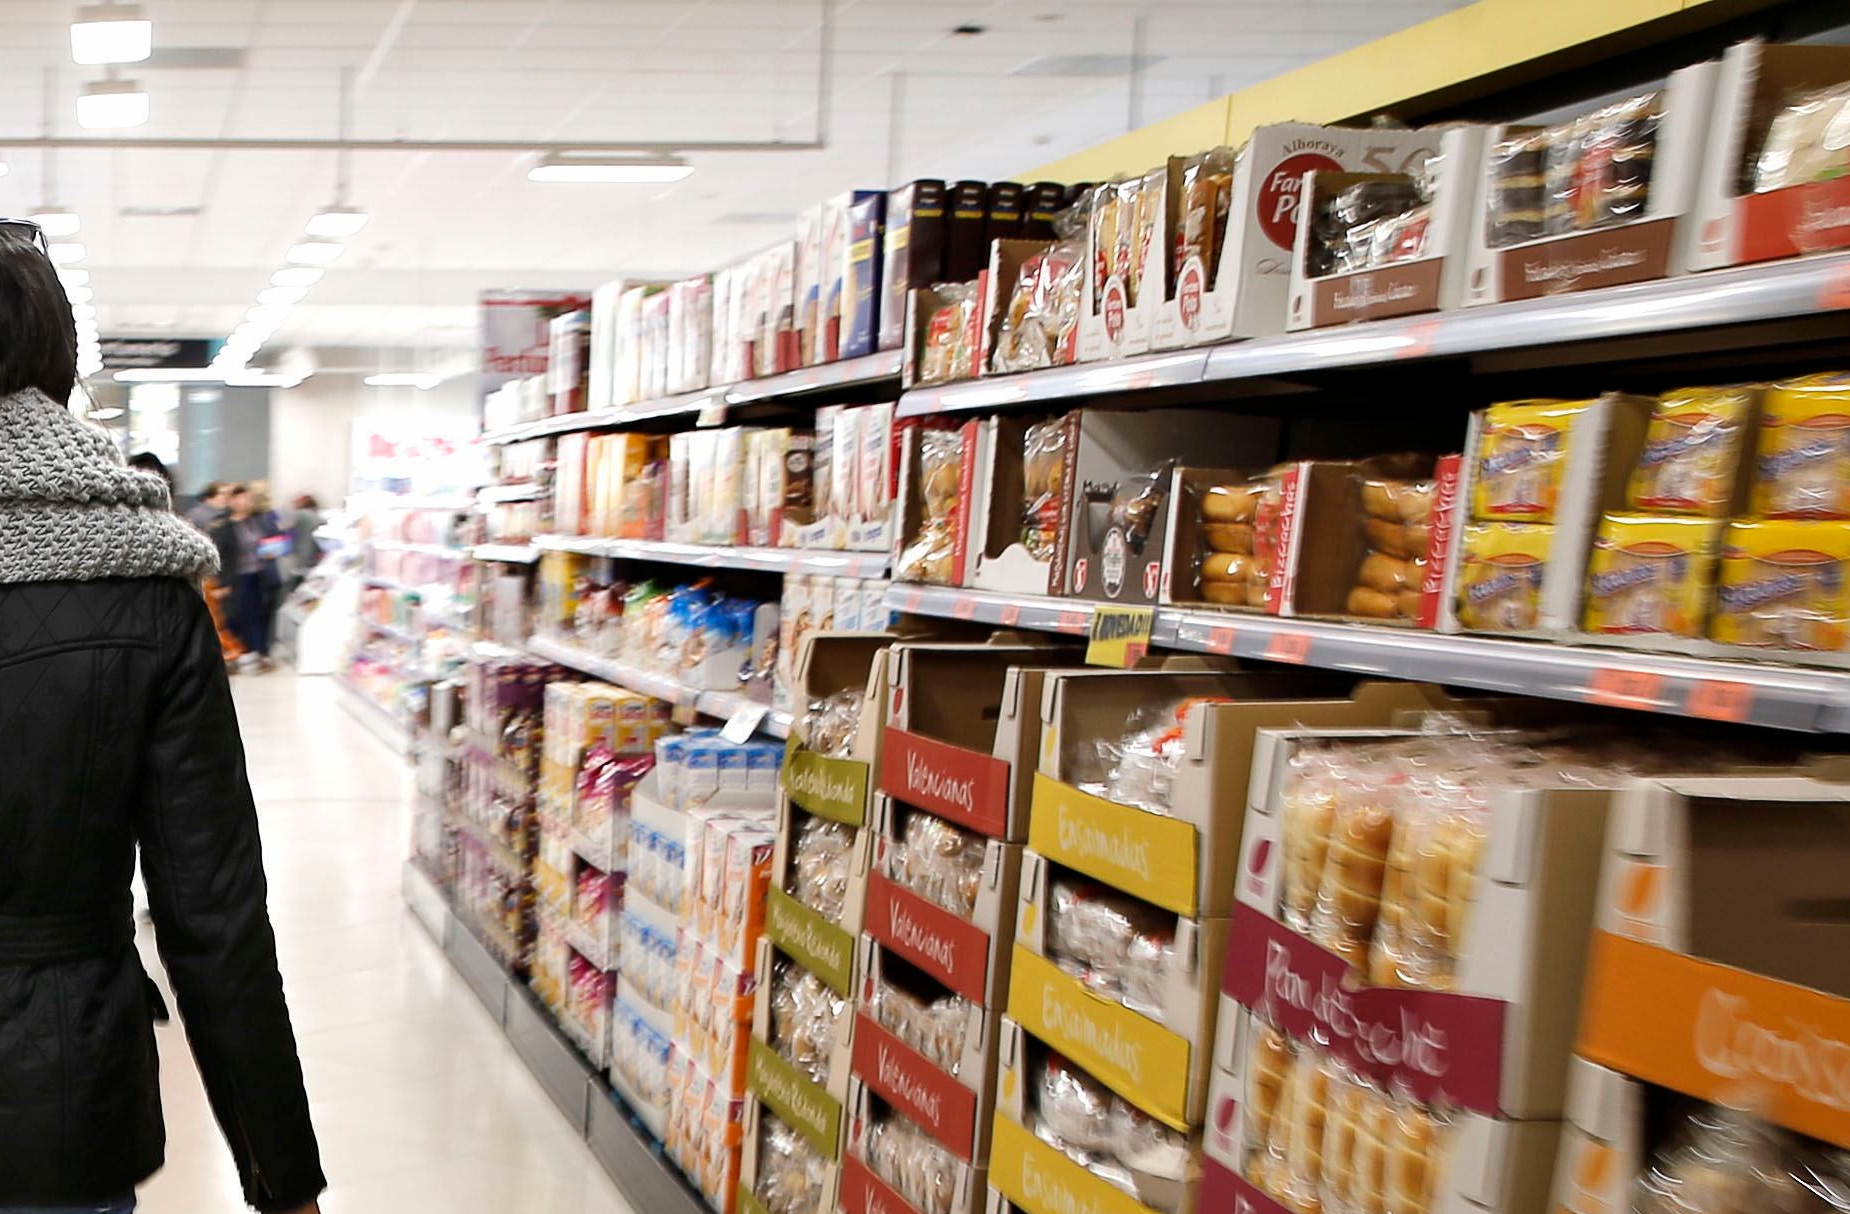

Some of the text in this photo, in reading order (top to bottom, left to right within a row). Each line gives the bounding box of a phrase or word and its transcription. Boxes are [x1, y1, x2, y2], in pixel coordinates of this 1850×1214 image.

[906, 748, 975, 812] Valencianas
[1057, 803, 1151, 881] Ensaimadas
[890, 898, 956, 974] Valencianas
